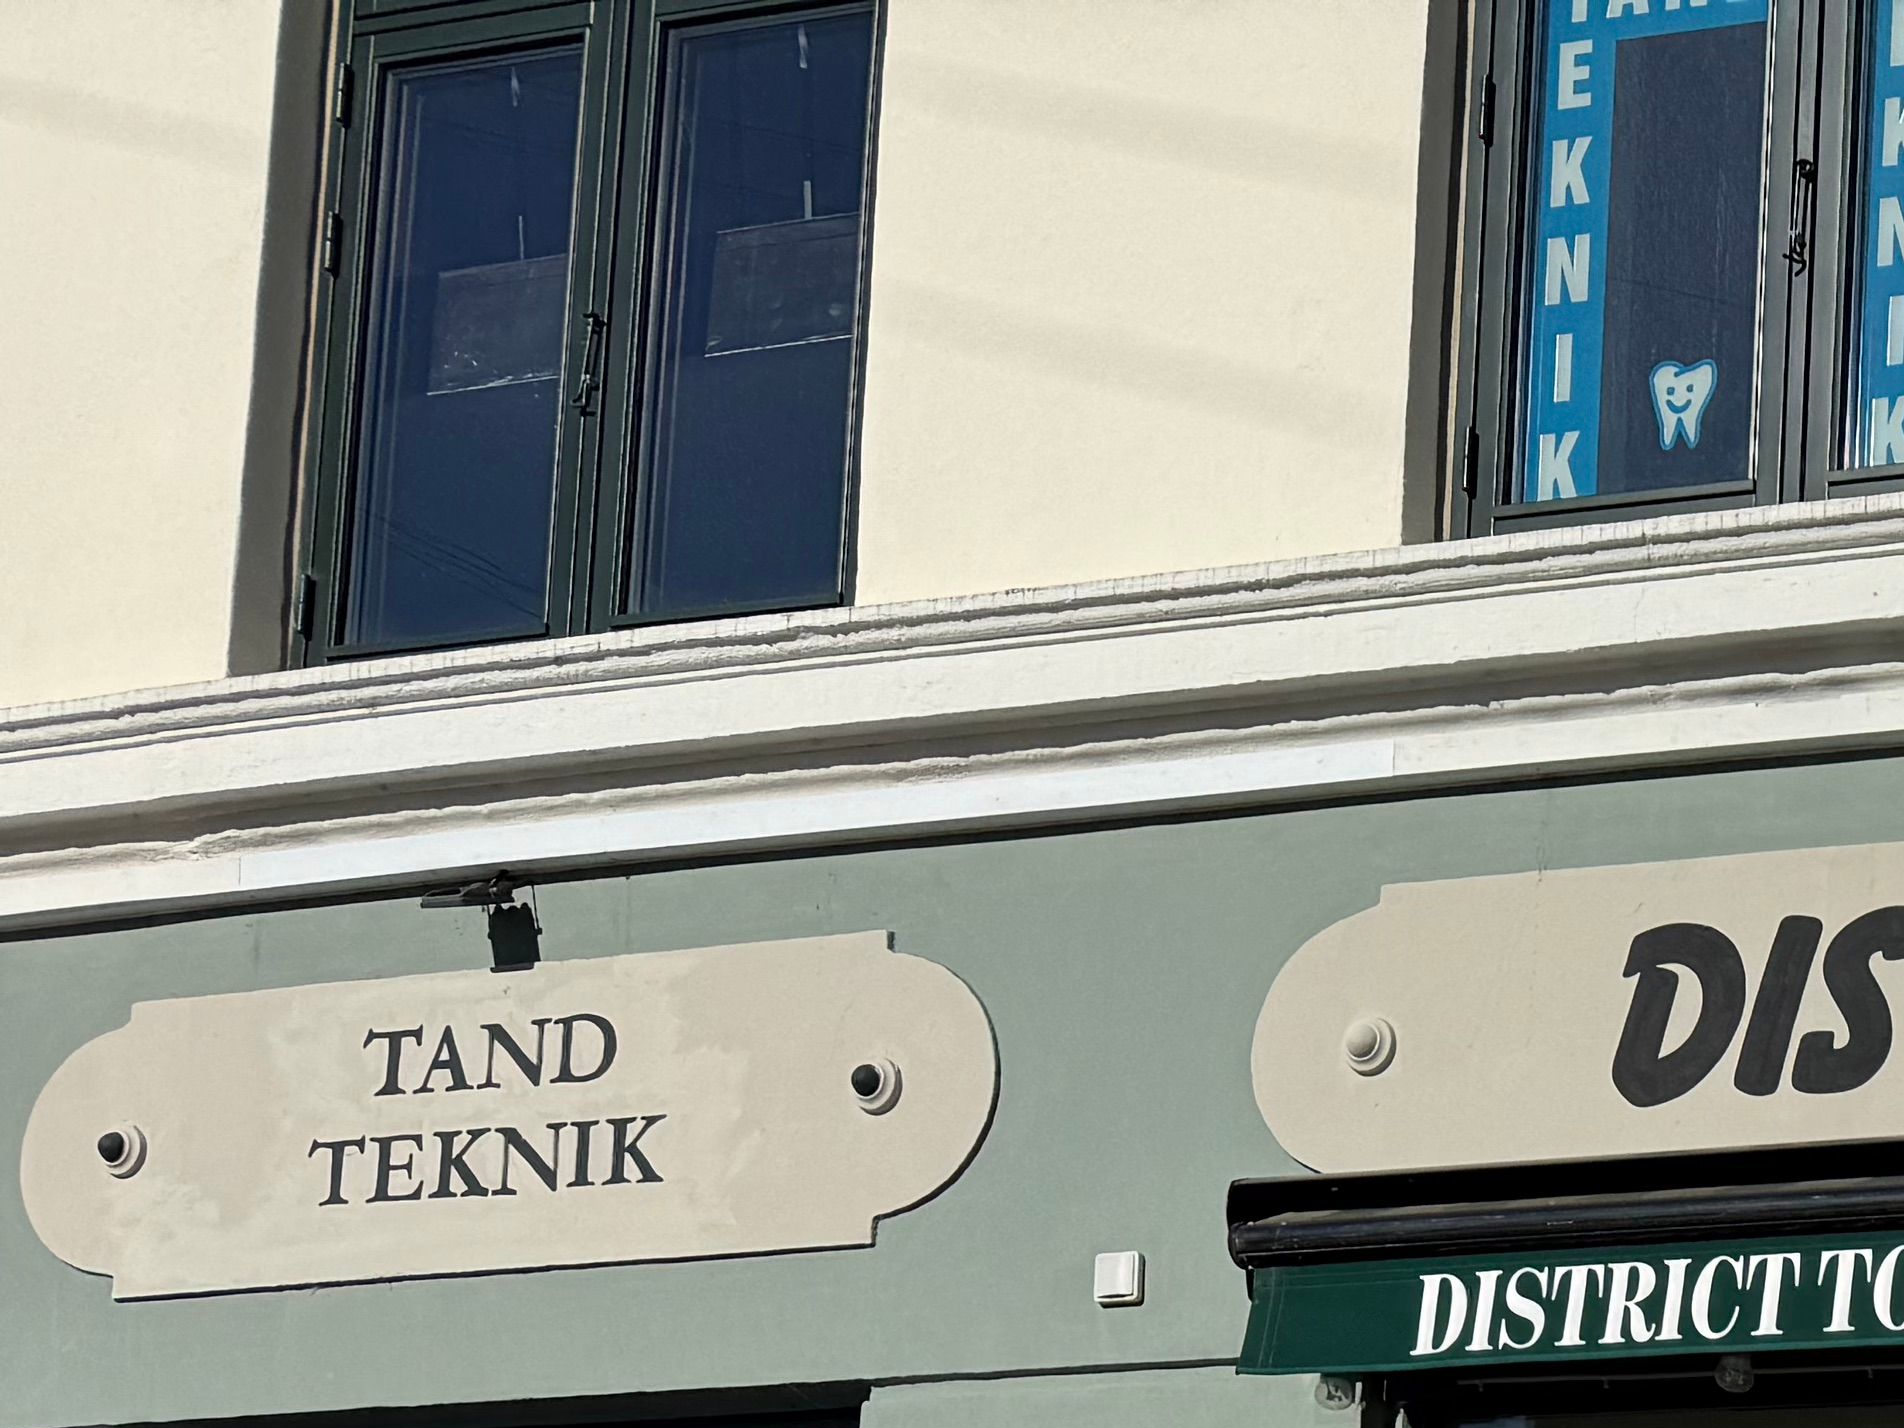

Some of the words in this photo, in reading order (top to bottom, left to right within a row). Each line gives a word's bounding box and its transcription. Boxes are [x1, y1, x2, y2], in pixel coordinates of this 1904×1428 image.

[363, 1011, 619, 1097] TAND
[308, 1113, 667, 1207] TEKNIK
[1409, 1251, 1801, 1357] DISTRICT
